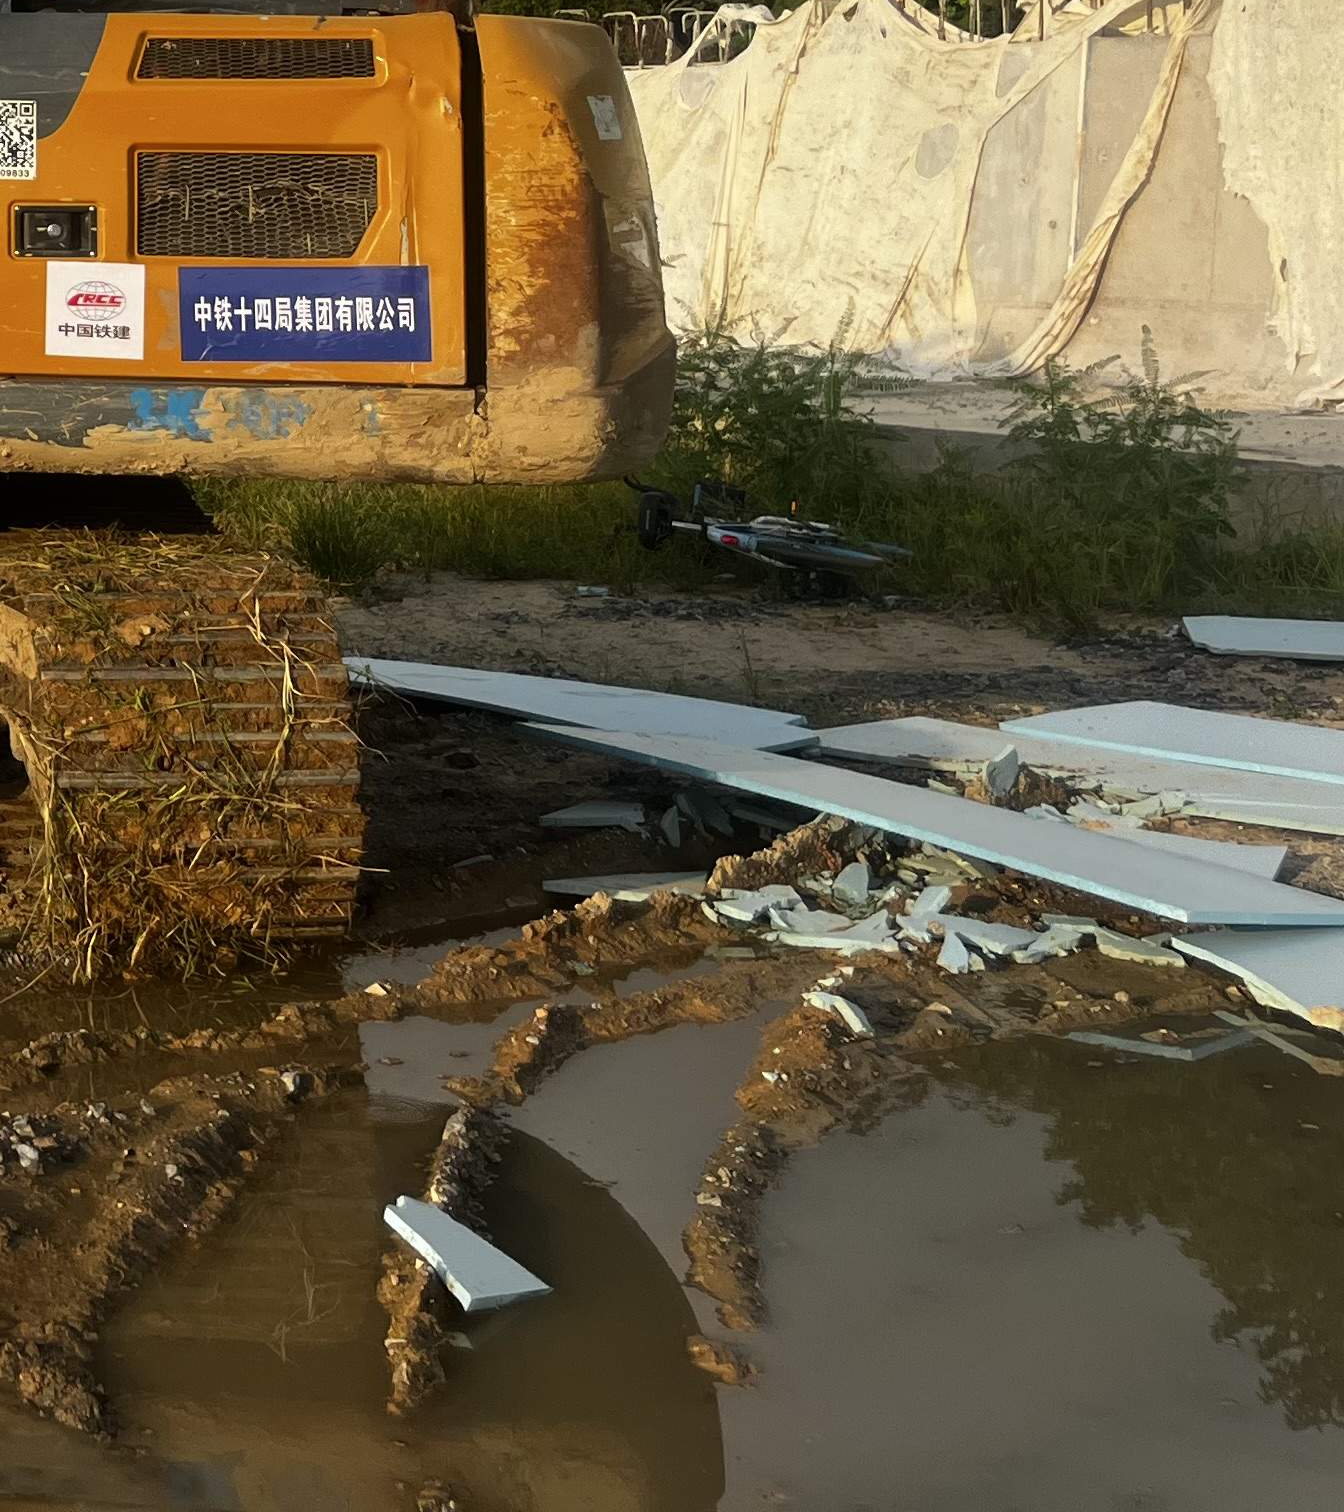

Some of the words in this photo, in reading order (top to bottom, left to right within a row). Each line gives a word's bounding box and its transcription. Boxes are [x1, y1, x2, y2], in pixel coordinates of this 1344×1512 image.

[67, 293, 125, 307] CRCC
[193, 295, 416, 333] 中铁十四局集团有限公司
[58, 322, 131, 340] 中国铁建
